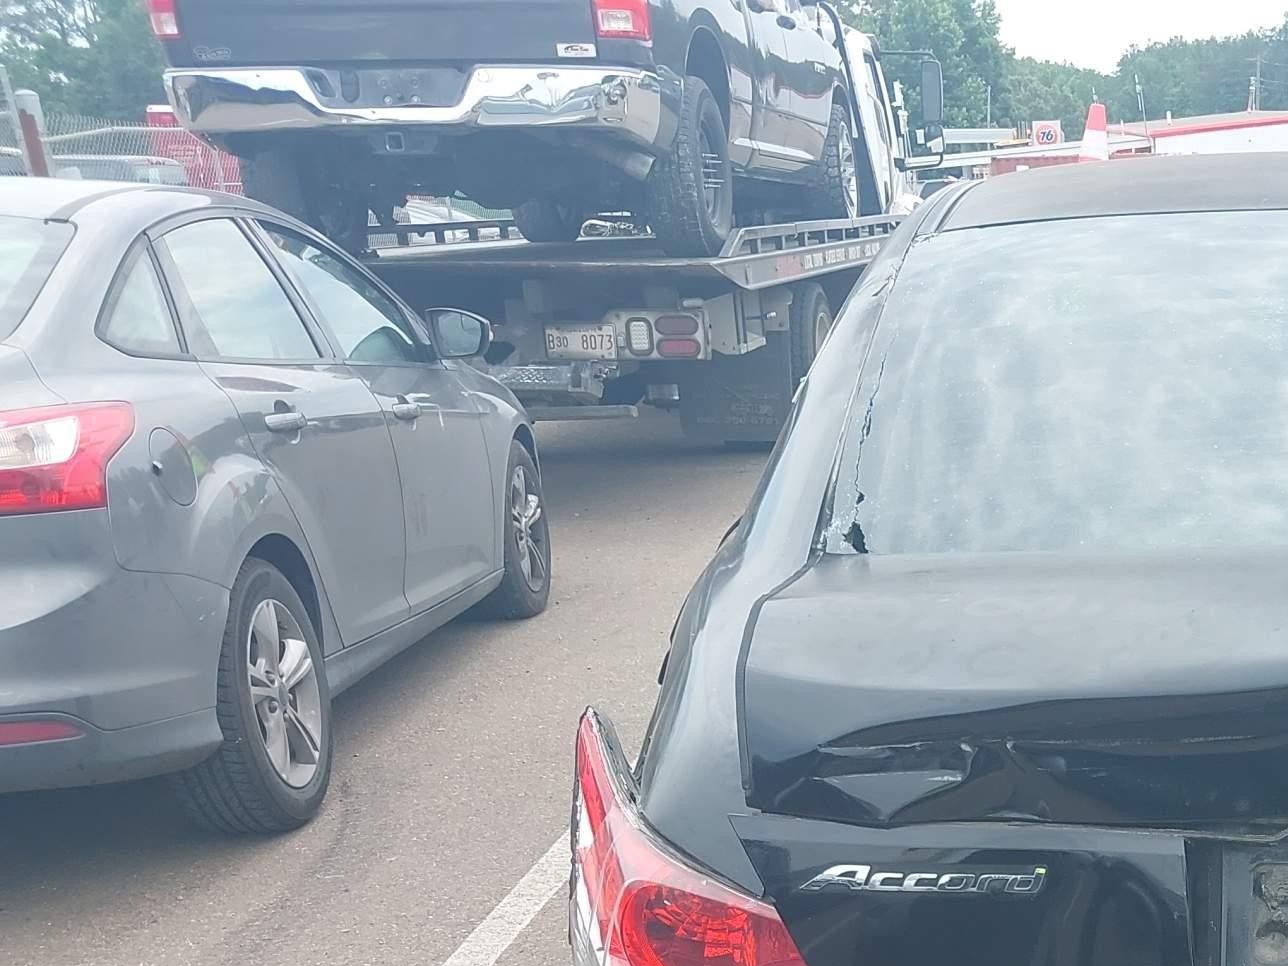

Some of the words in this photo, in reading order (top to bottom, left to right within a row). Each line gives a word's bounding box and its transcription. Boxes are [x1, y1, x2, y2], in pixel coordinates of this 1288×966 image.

[1040, 130, 1054, 141] 76
[581, 334, 614, 351] 8073
[799, 864, 1047, 893] Accord
